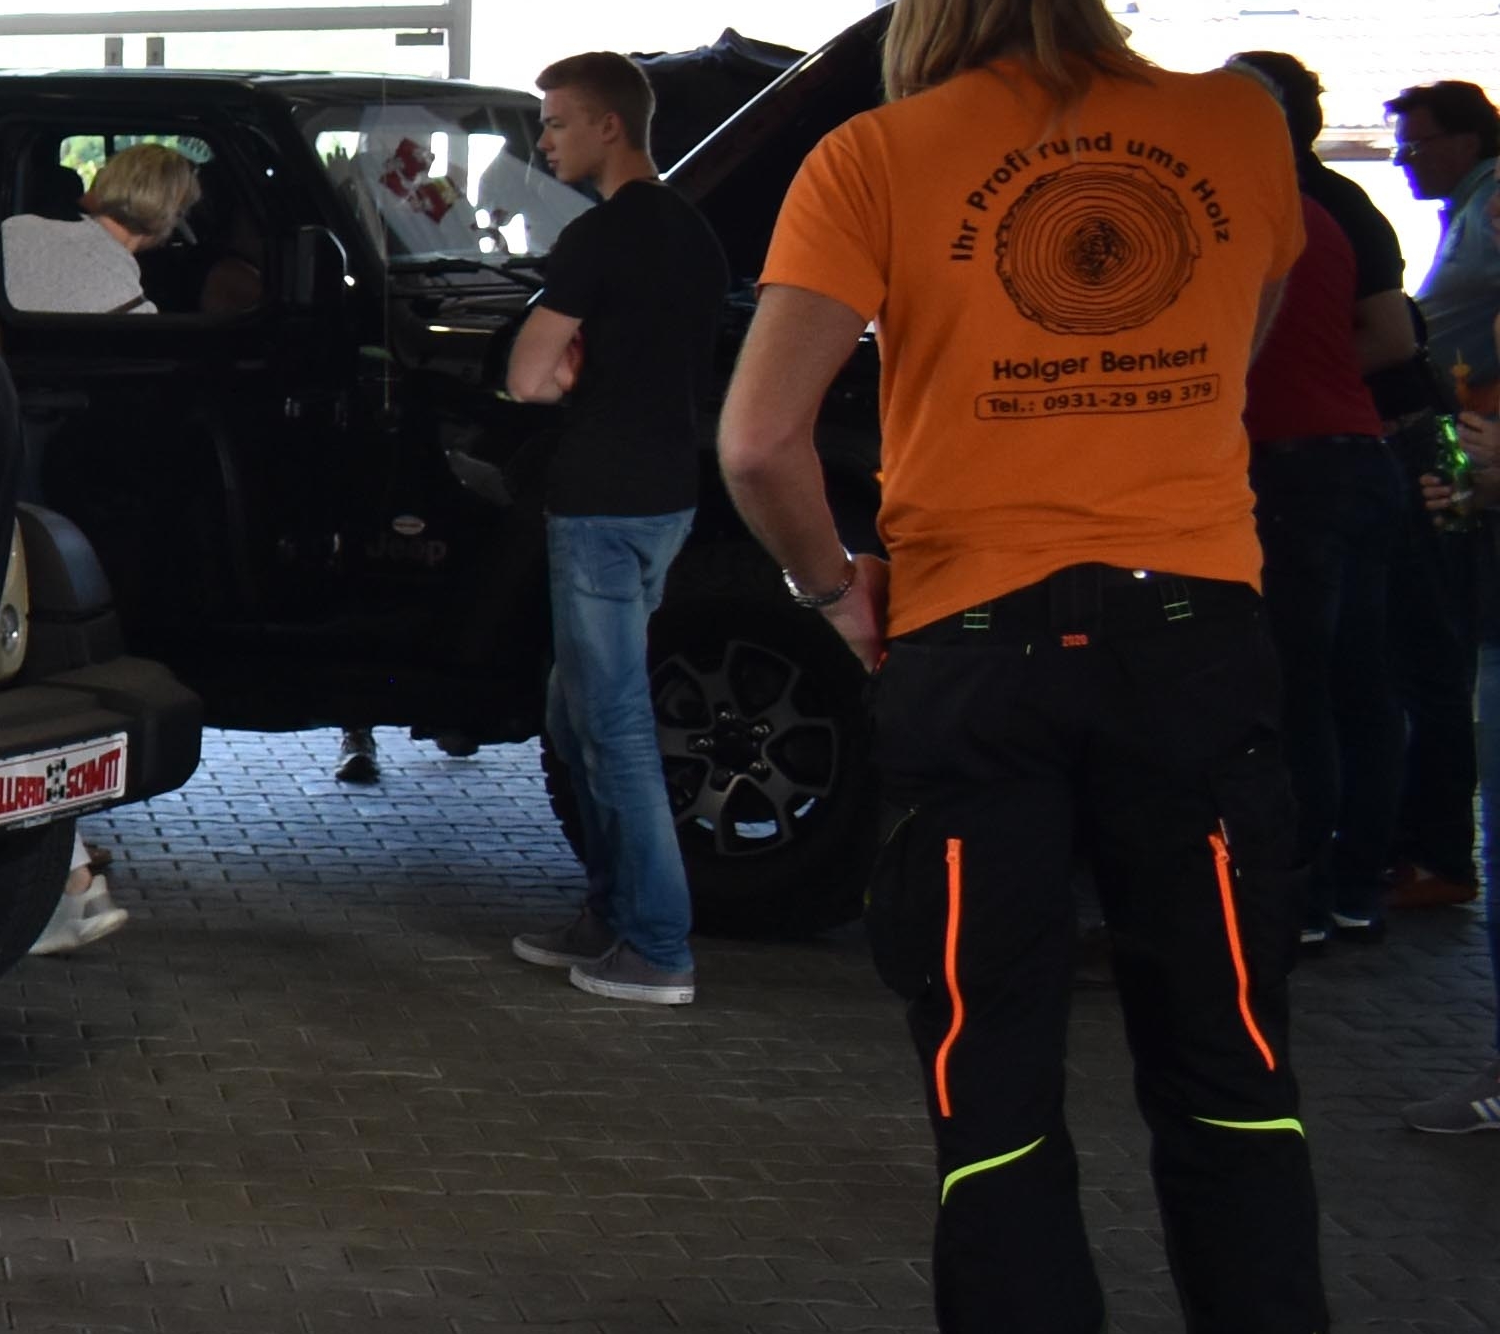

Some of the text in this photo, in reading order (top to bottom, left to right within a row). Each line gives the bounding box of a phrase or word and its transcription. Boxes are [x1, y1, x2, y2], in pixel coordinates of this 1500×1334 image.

[950, 132, 1231, 262] Ihr Profi rund ums Holz
[992, 343, 1208, 383] Holger Benkert
[988, 381, 1211, 415] Tel.: 0931-29 99 379
[66, 748, 121, 800] SCHMITT
